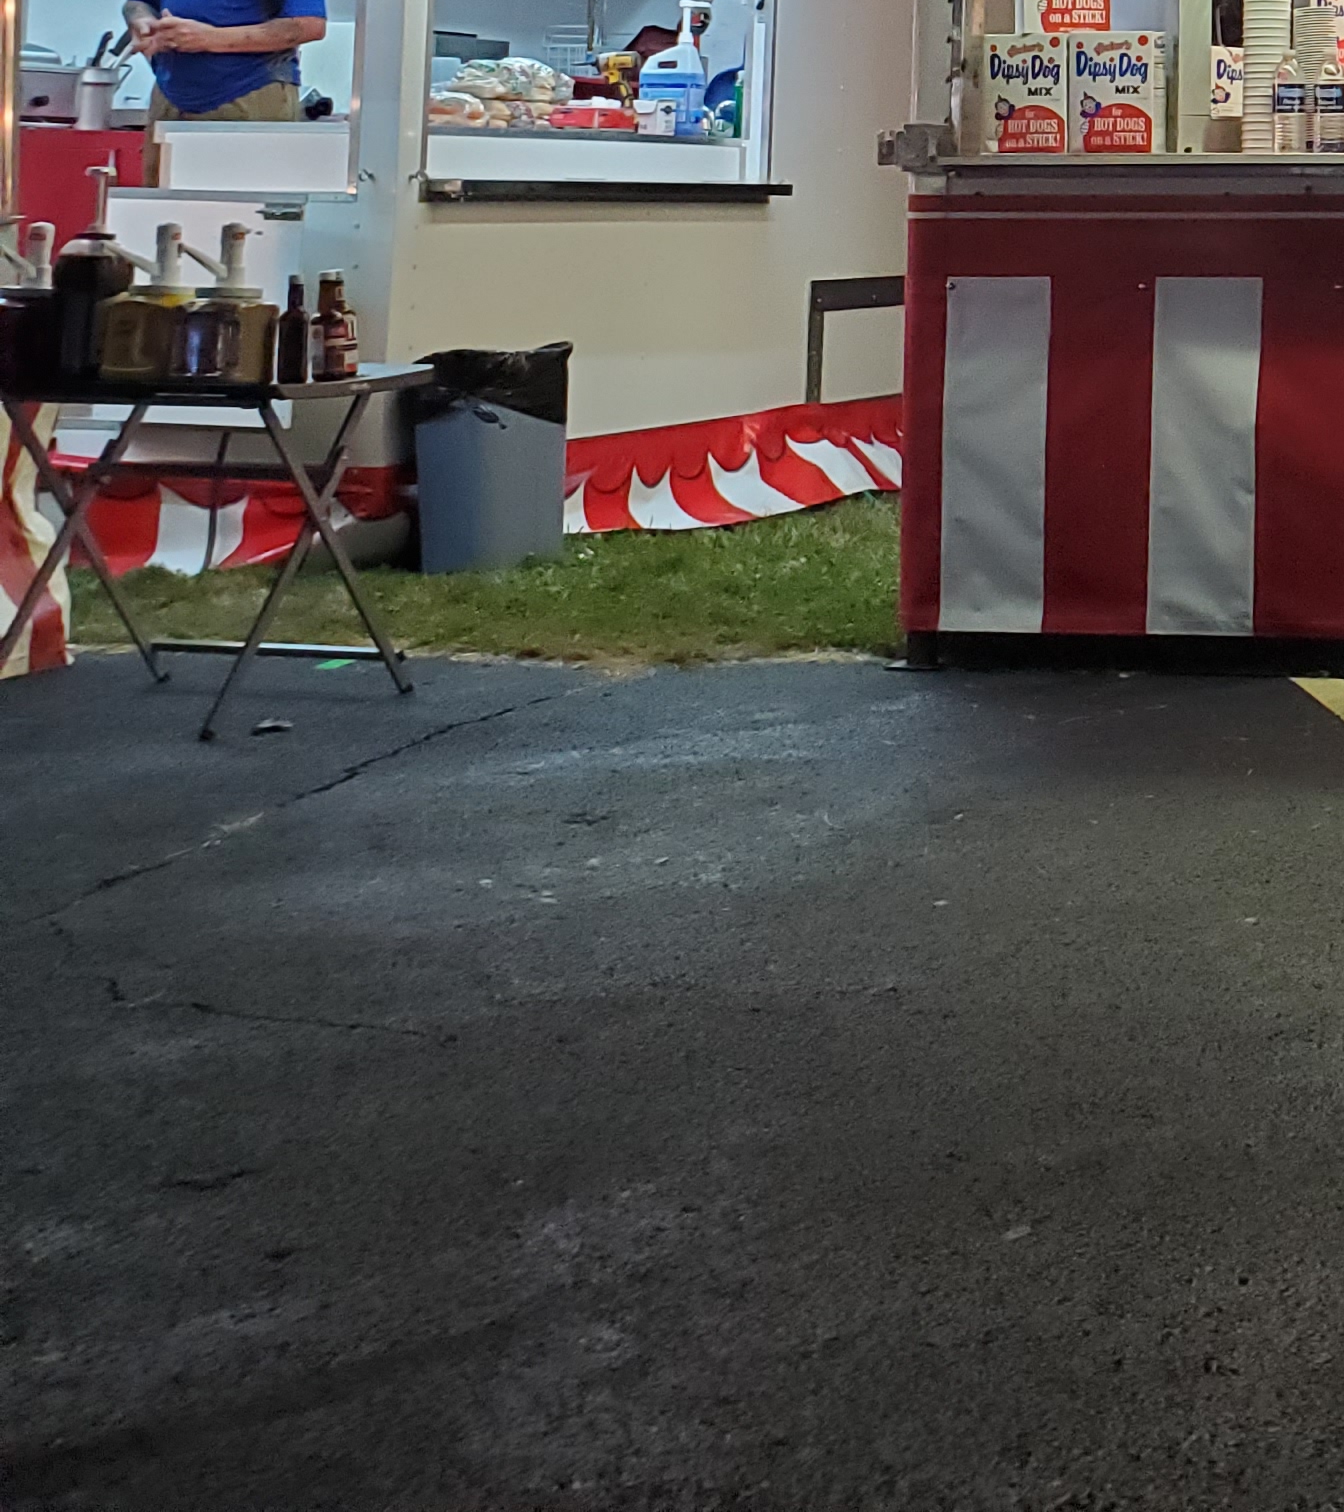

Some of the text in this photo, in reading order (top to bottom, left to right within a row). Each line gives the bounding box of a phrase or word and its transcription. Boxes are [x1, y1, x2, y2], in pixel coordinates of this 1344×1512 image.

[1072, 10, 1106, 24] STICK!
[1076, 50, 1116, 82] Dipsy
[1119, 52, 1148, 84] Dog
[1216, 58, 1242, 84] Dips
[1028, 87, 1053, 96] MIX
[1115, 85, 1141, 94] MIX
[1094, 118, 1146, 131] HOT DOGS
[1112, 132, 1147, 146] STICK!
